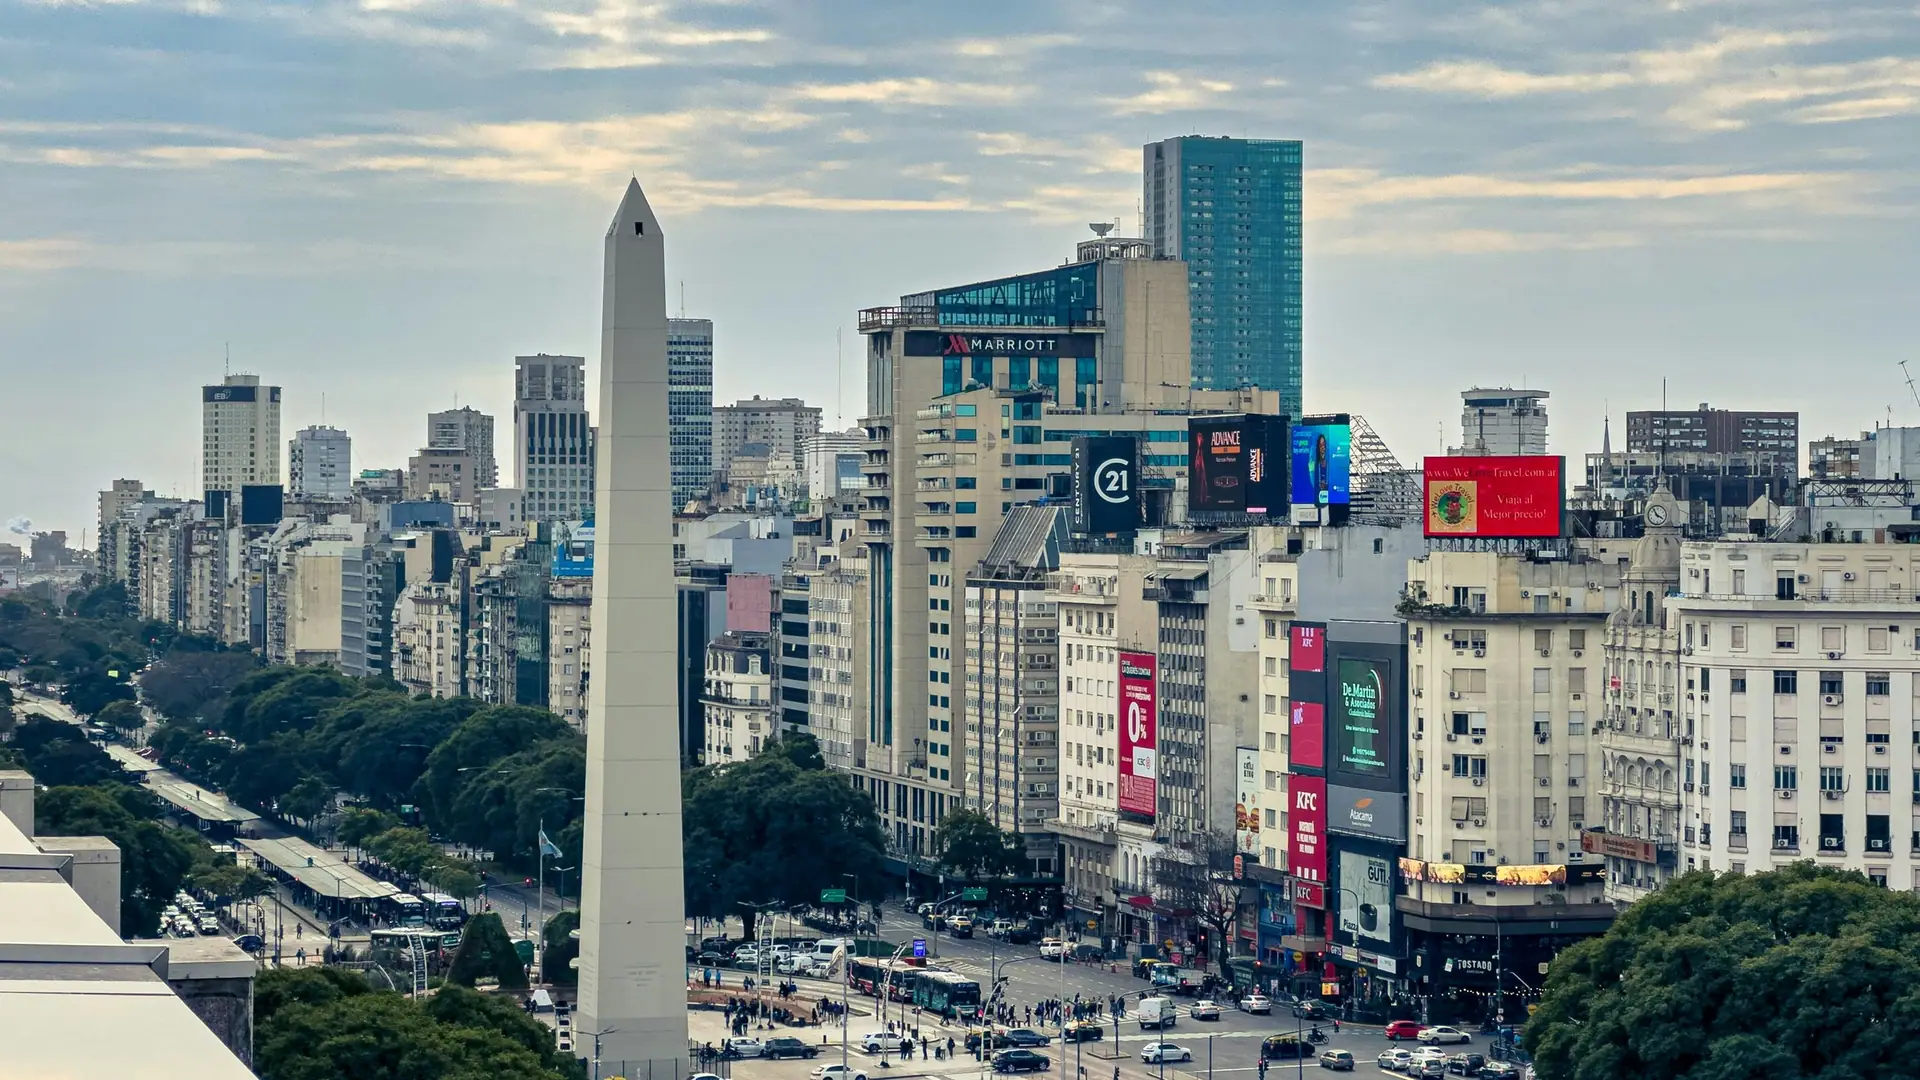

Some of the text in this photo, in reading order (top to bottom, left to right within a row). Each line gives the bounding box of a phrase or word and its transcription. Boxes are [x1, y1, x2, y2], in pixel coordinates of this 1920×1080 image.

[971, 339, 1055, 351] MARRIOTT
[1211, 430, 1240, 446] ADVANCE
[1074, 447, 1080, 459] 21
[1496, 494, 1533, 505] Viaja al
[1483, 509, 1546, 520] Mejor precio!
[1302, 638, 1313, 648] KFC
[1350, 697, 1376, 710] Asociados
[1296, 791, 1317, 811] KFC
[1350, 808, 1373, 822] Atacama
[1297, 886, 1311, 900] KFC
[1458, 959, 1492, 972] TOSTADO
